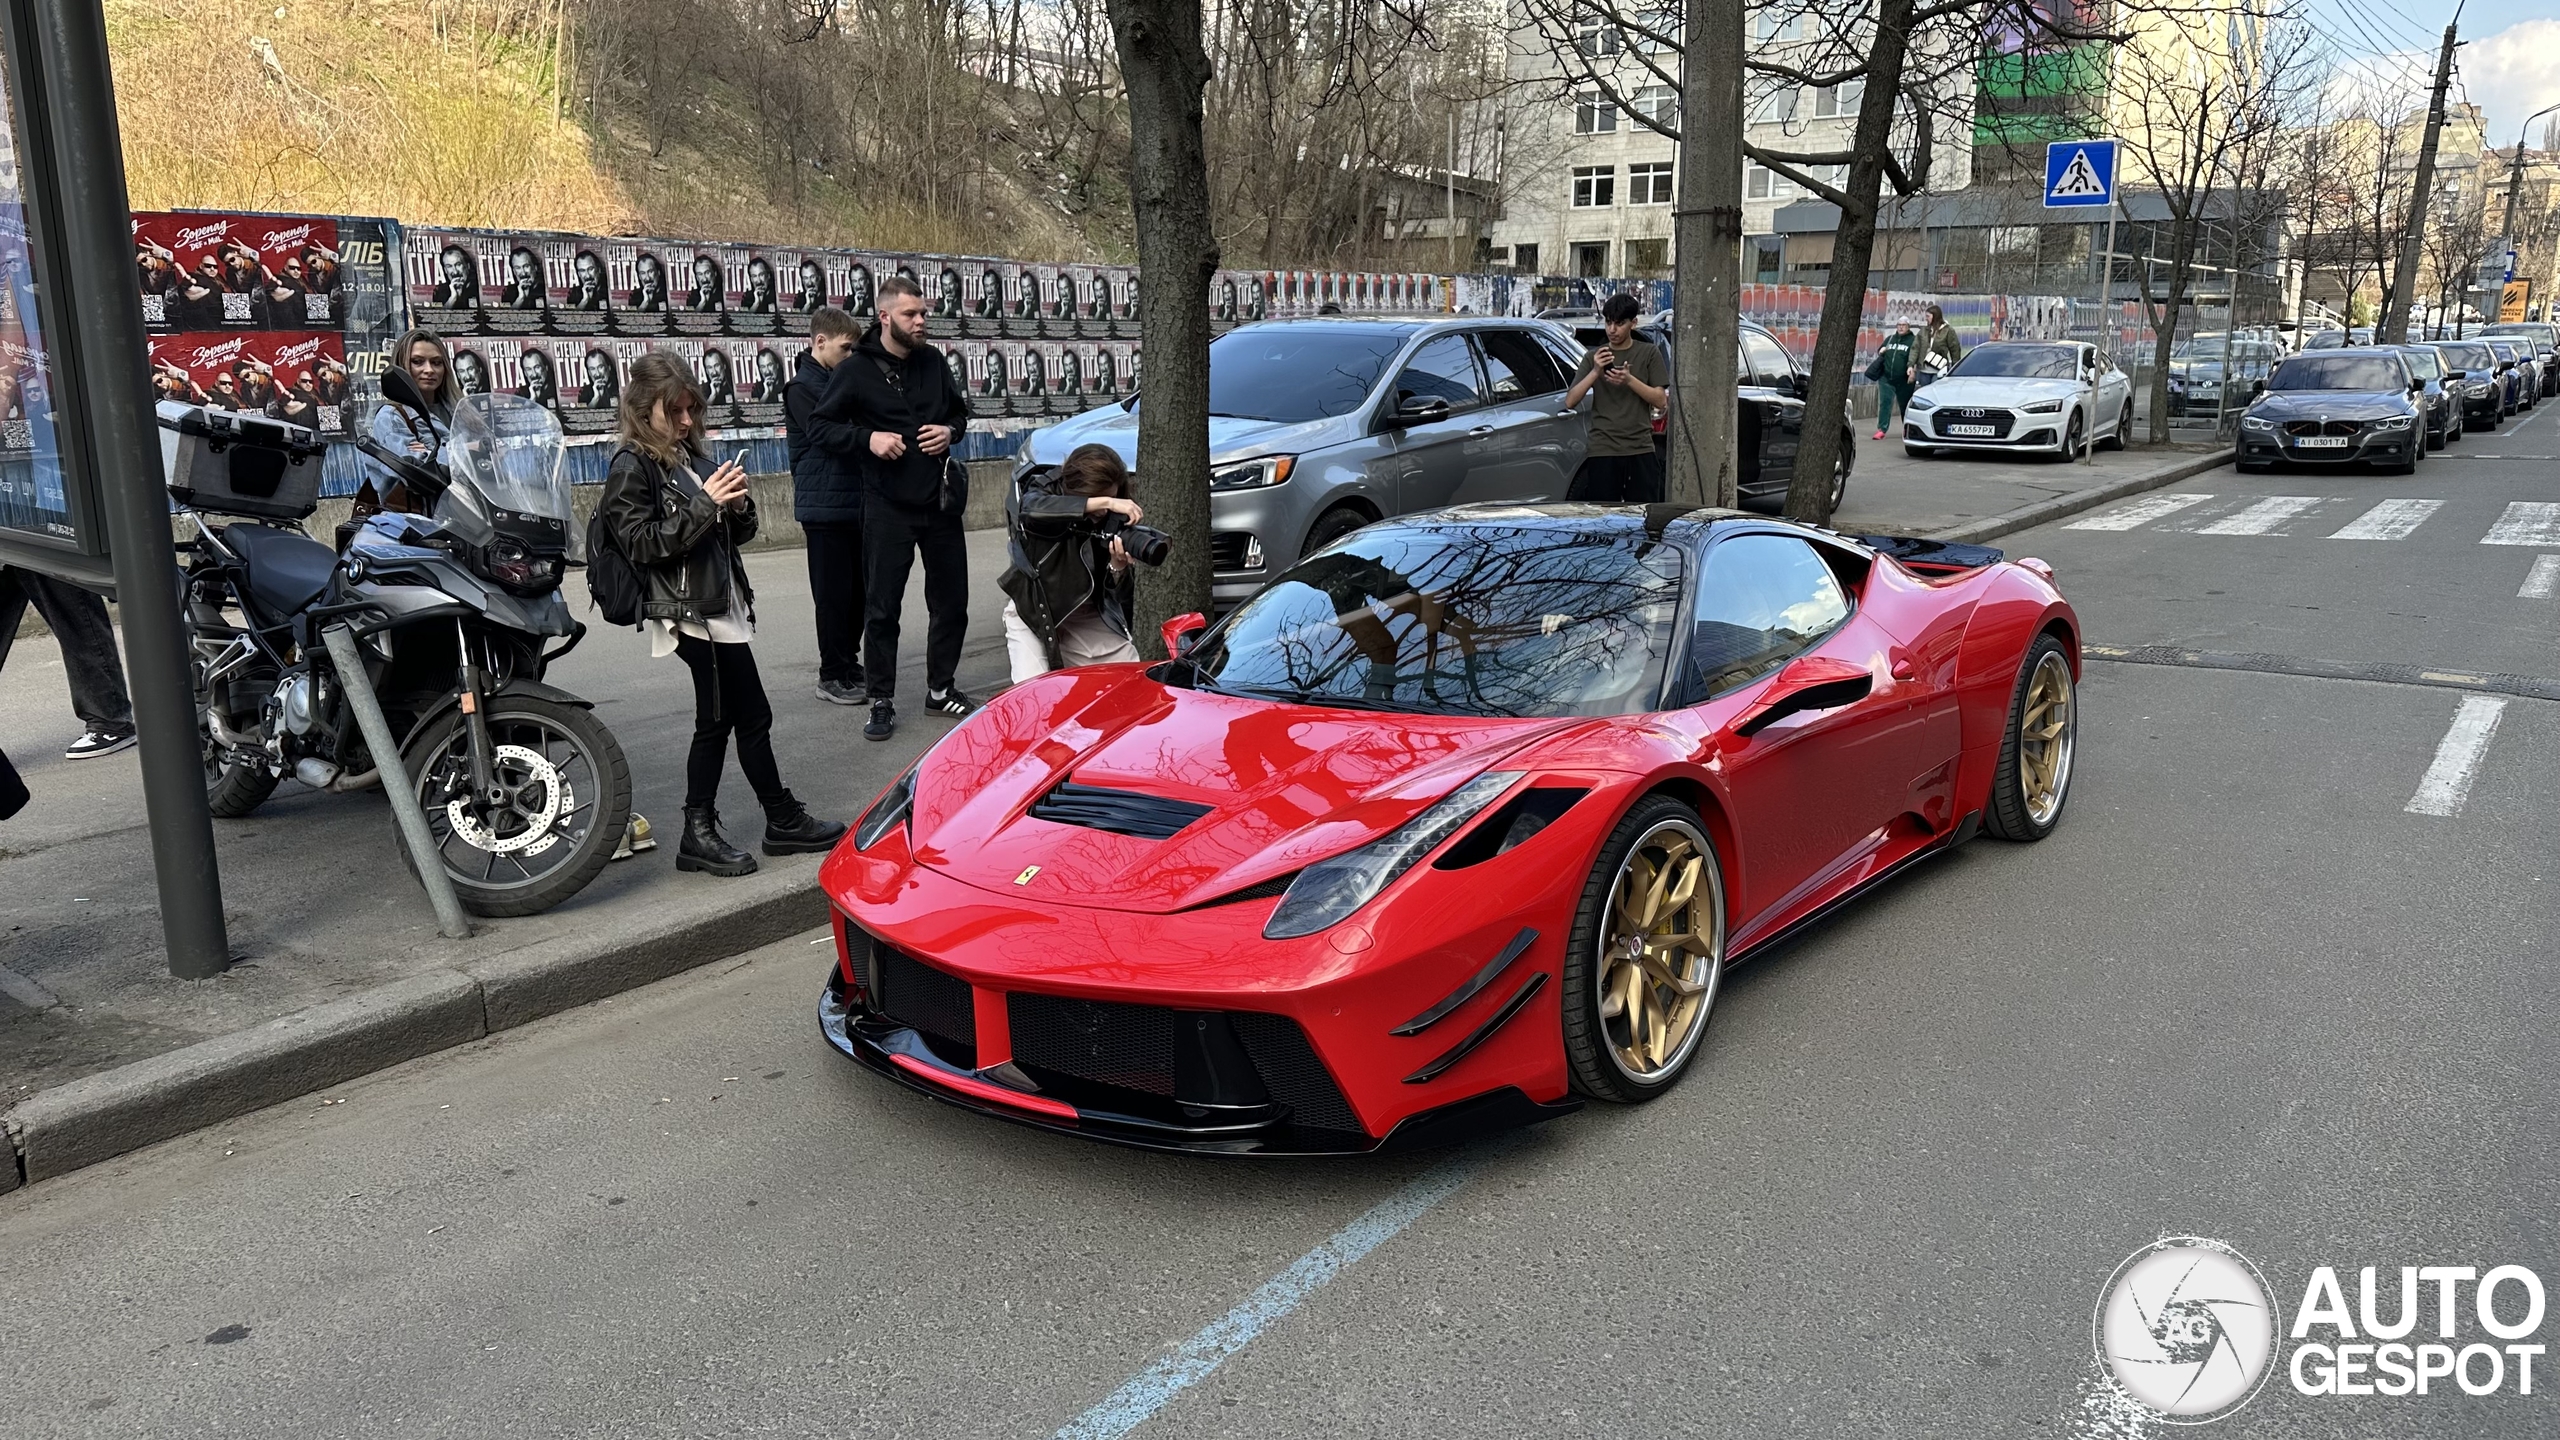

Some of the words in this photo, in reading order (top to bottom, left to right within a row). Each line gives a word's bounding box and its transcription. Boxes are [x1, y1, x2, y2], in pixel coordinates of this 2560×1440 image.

[408, 236, 442, 253] СТЕПАН
[477, 238, 511, 255] СТЕПАН
[544, 242, 576, 258] СТЕПАН
[606, 246, 637, 262] СТЕПАН
[665, 247, 695, 262] СТЕПАН
[408, 253, 446, 285] ГІГА
[723, 250, 750, 265] СТЕПАН
[775, 252, 801, 267] СТЕПАН
[826, 255, 851, 270] СТЕПАН
[478, 255, 515, 286] ГІГА
[545, 258, 580, 288] ГІГА
[607, 261, 640, 290] ГІГА
[666, 262, 698, 291] ГІГА
[724, 264, 751, 292] ГІГА
[776, 267, 803, 294] ГІГА
[827, 270, 853, 296] ГІГА
[963, 276, 985, 300] ГІГА
[1002, 277, 1022, 301] ГІГА
[1040, 279, 1060, 302] ГІГА
[488, 341, 522, 357] СТЕПАН
[554, 341, 586, 357] СТЕПАН
[617, 342, 647, 358] СТЕПАН
[675, 341, 704, 357] СТЕПАН
[731, 341, 758, 356] СТЕПАН
[489, 358, 526, 389] ГІГА
[556, 357, 590, 387] ГІГА
[733, 356, 761, 384] ГІГА
[968, 356, 989, 380] ГІГА
[1008, 356, 1028, 379] ГІГА
[1045, 356, 1065, 379] ГІГА
[1081, 356, 1100, 378] ГІГА
[1116, 356, 1134, 378] ГІГА
